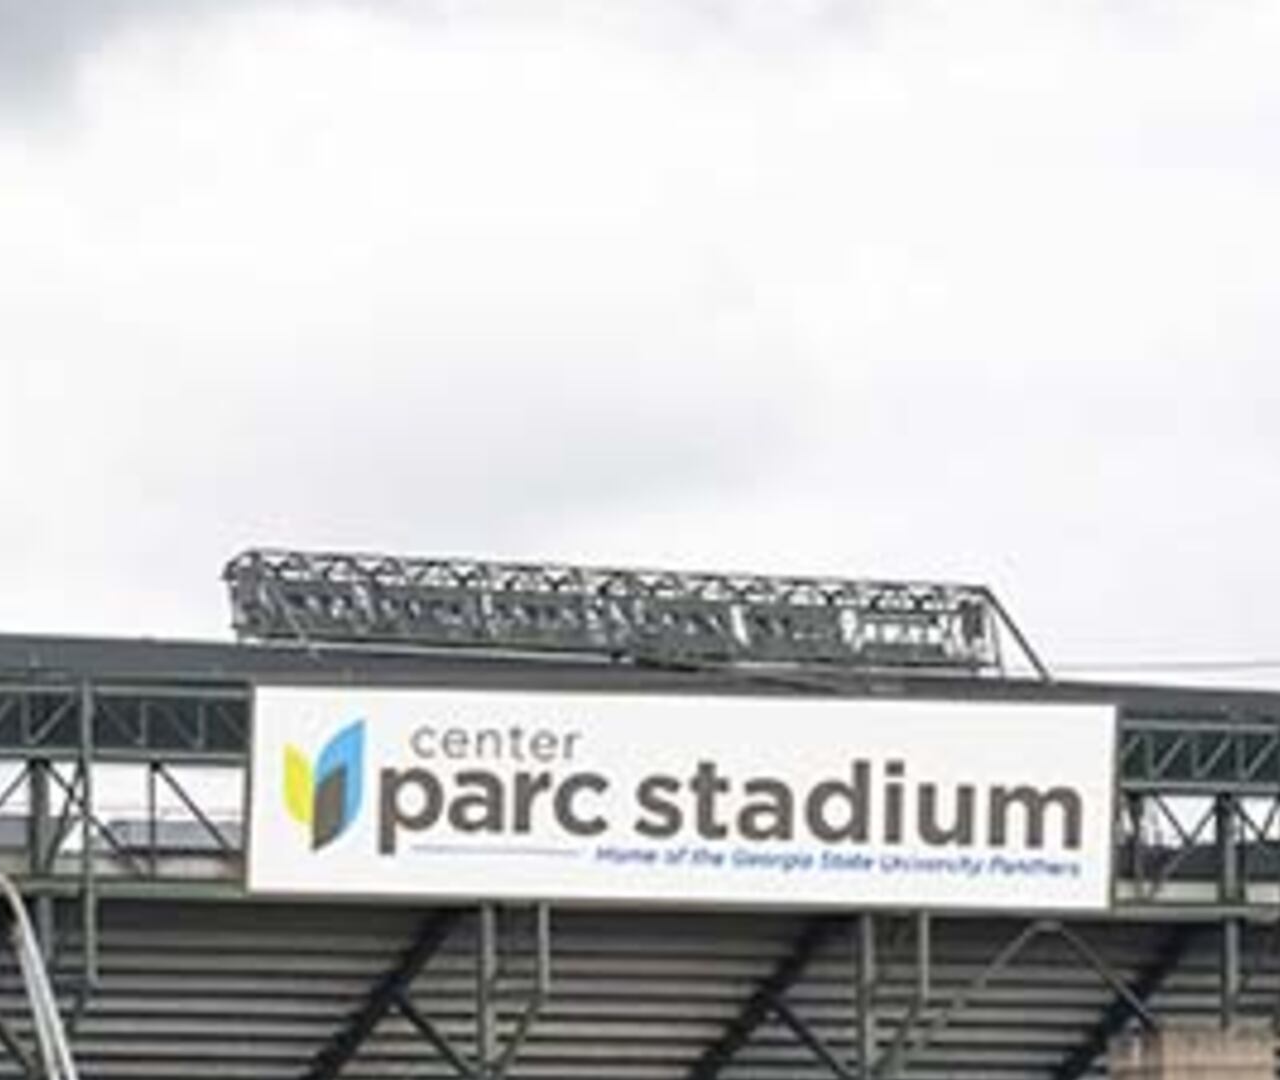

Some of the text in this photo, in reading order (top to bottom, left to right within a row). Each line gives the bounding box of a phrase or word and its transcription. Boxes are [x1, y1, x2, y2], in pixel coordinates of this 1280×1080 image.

[409, 725, 583, 761] center
[378, 758, 1084, 856] parc stadium
[596, 846, 1083, 878] Home of the Georgia State University Panthers
